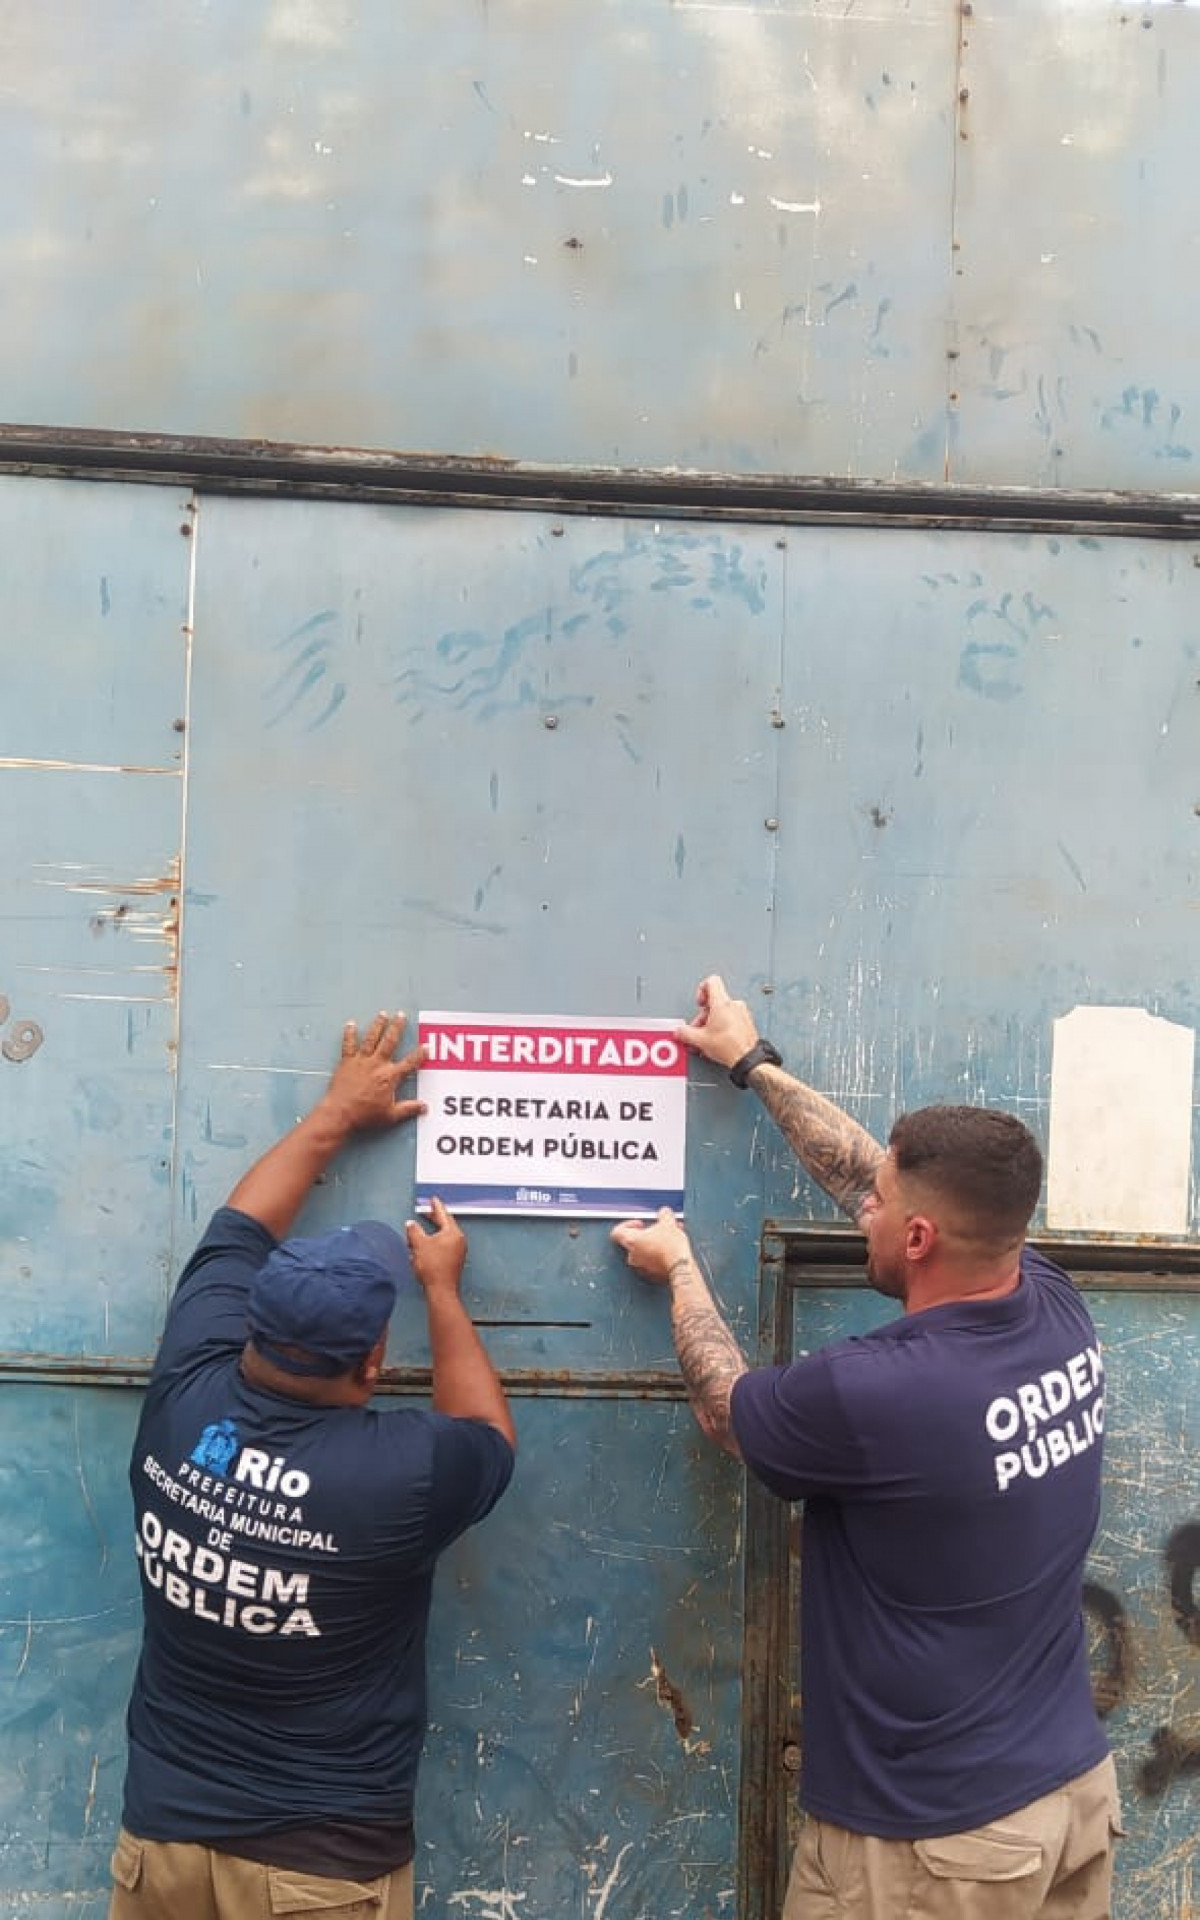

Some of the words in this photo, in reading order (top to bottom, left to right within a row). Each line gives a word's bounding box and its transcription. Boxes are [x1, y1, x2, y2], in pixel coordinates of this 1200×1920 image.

[427, 1032, 678, 1069] INTERDITADO
[443, 1096, 609, 1121] SECRETARIA
[619, 1101, 654, 1122] DE
[436, 1135, 533, 1159] ORDEM
[544, 1132, 658, 1161] PÚBLICA
[178, 1463, 302, 1523] PREFEITURA
[236, 1448, 311, 1498] Rio
[143, 1455, 226, 1525] SECRETARIA
[230, 1513, 339, 1552] MUNICIPAL
[142, 1511, 309, 1603] ORDEM
[208, 1529, 234, 1551] DE
